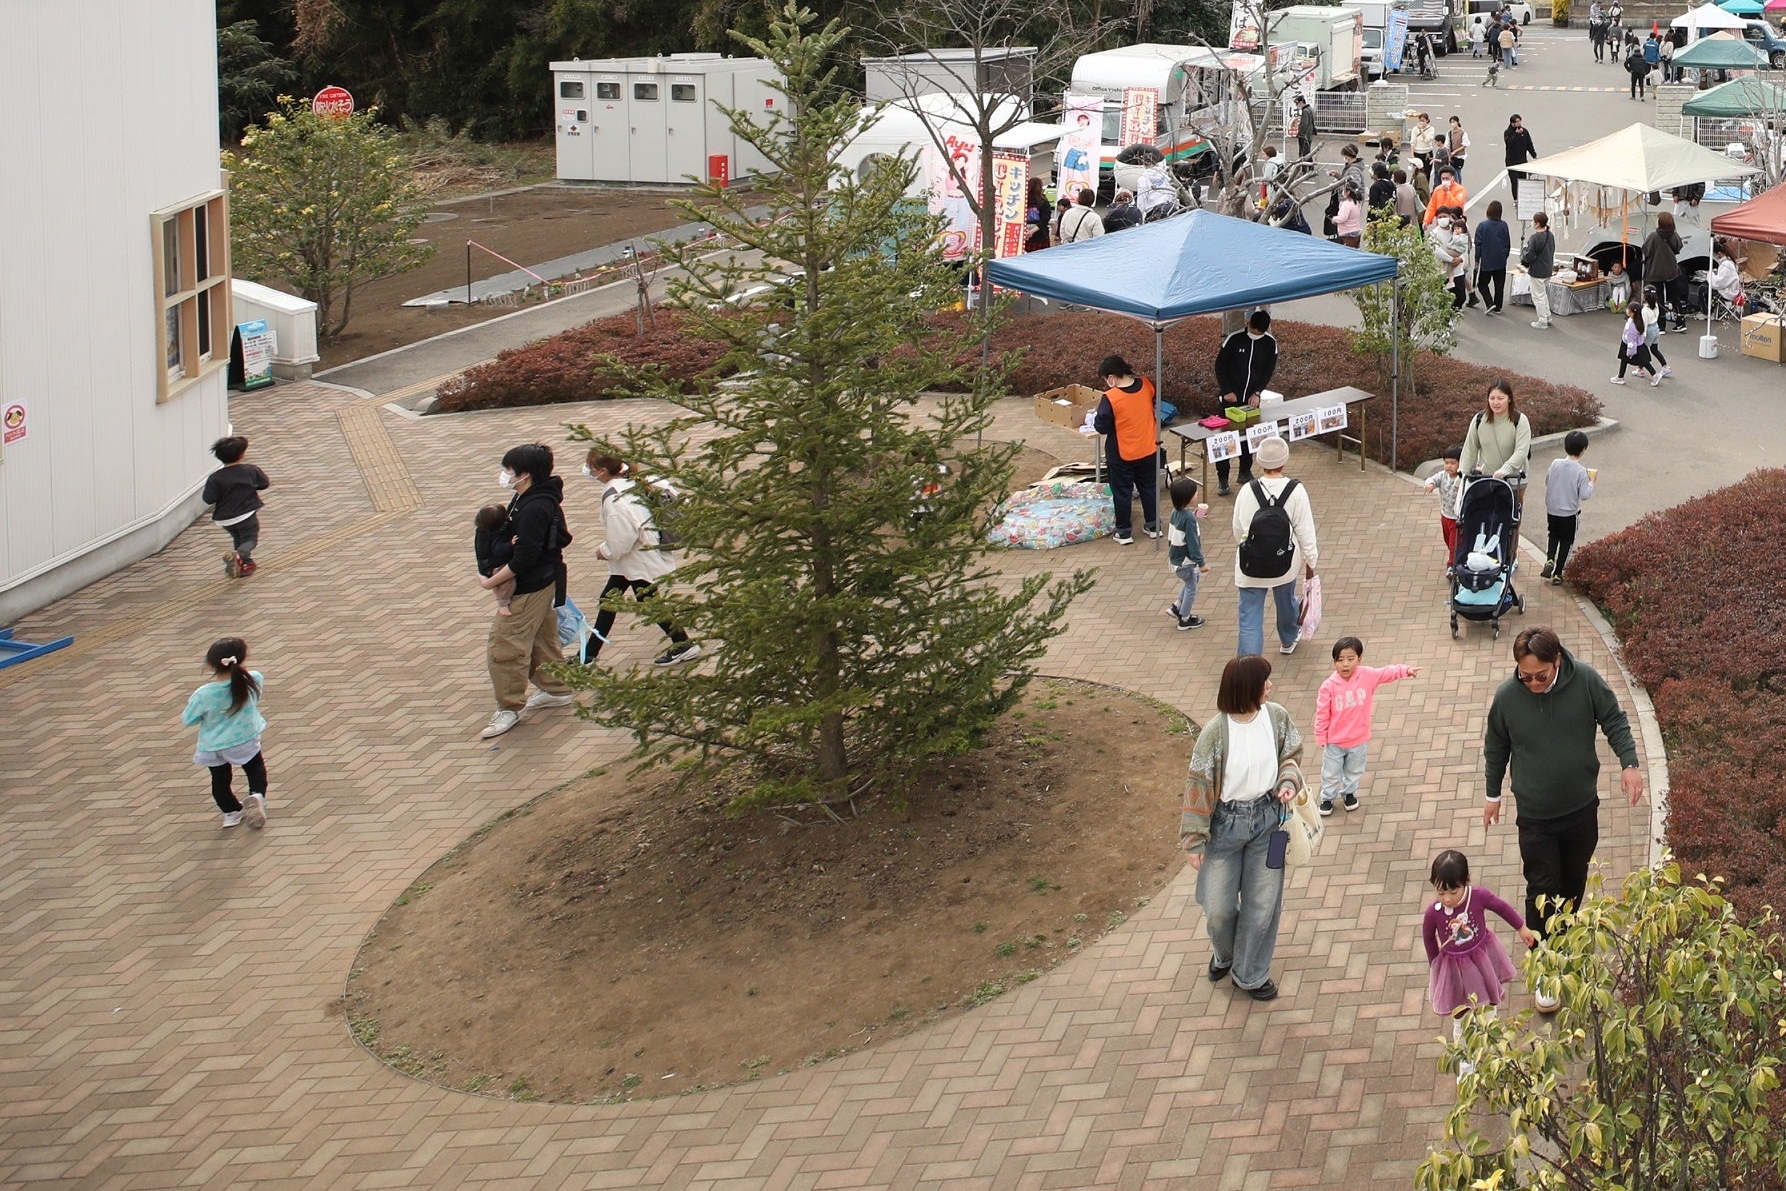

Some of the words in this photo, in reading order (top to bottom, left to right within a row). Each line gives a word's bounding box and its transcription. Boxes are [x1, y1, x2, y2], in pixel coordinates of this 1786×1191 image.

[945, 135, 975, 153] Ayu
[1005, 165, 1023, 222] キッチン
[1336, 688, 1367, 711] GAP
